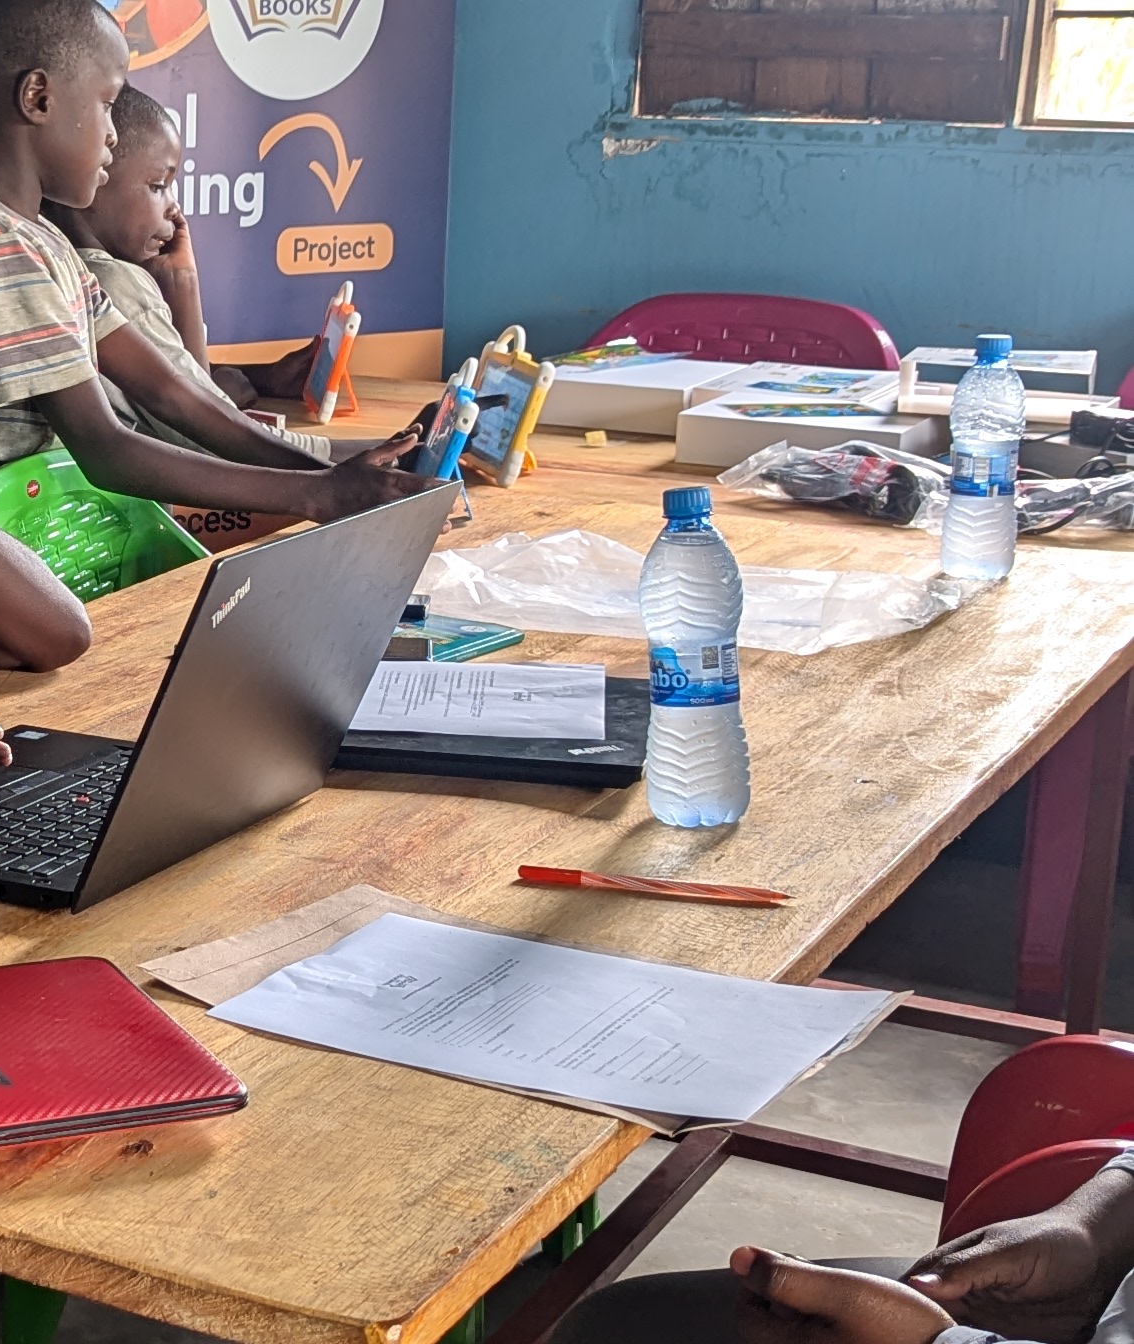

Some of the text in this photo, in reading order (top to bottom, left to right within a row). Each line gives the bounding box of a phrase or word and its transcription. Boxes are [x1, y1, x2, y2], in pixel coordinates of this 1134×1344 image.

[293, 235, 375, 267] Project
[174, 510, 251, 534] ccess
[211, 576, 251, 629] ThinkPad
